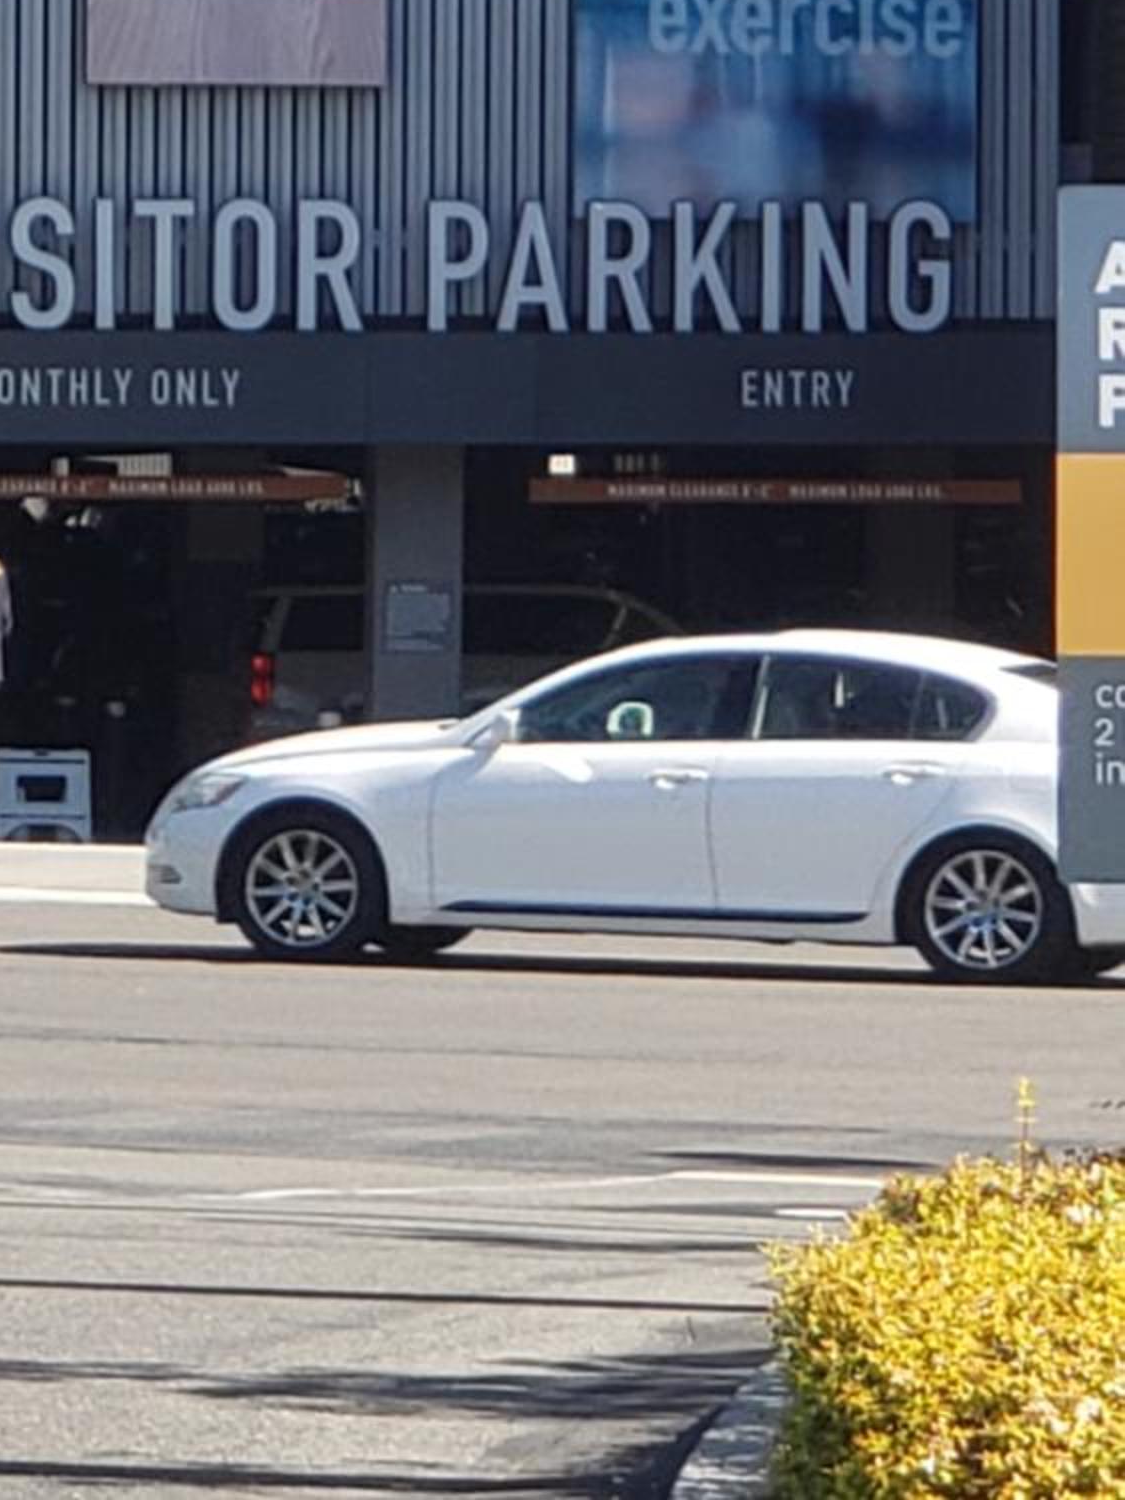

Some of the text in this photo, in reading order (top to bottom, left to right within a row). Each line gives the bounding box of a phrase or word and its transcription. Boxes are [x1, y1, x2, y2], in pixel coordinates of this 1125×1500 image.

[426, 201, 952, 333] PARKING
[150, 368, 241, 409] ONLY
[740, 370, 854, 408] ENTRY
[1094, 717, 1115, 747] 2
